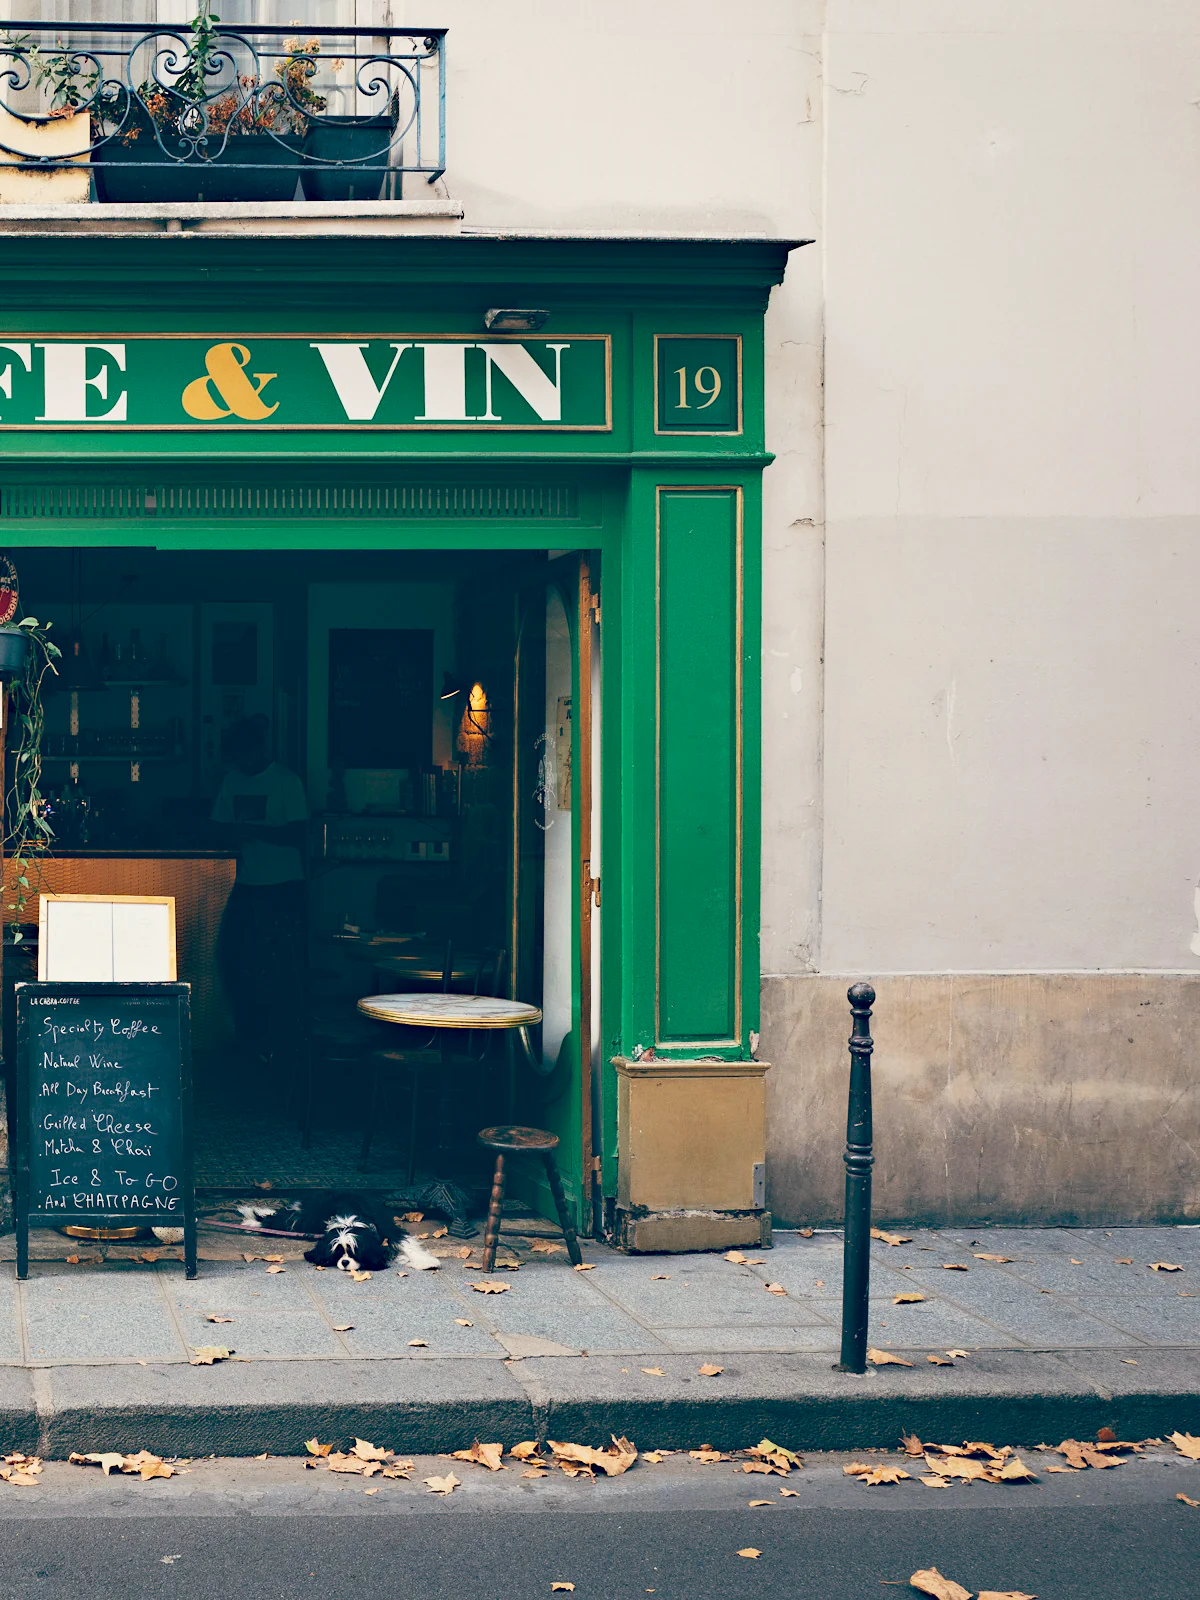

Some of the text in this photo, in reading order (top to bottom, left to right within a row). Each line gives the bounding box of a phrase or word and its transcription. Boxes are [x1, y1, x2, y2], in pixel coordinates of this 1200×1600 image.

[181, 343, 280, 421] &
[309, 343, 571, 421] VIN
[673, 366, 722, 410] 19
[43, 1016, 162, 1043] Specialty Coffee
[43, 1052, 124, 1069] Natural Wine
[42, 1081, 160, 1104] All Day Breakfast
[43, 1113, 159, 1135] Grilled Cheese
[45, 1138, 85, 1156] Matcha
[91, 1138, 102, 1154] &
[50, 1168, 79, 1186] Ice
[90, 1168, 102, 1187] &
[114, 1170, 139, 1186] To
[45, 1192, 180, 1211] And CHAMPAGNE
